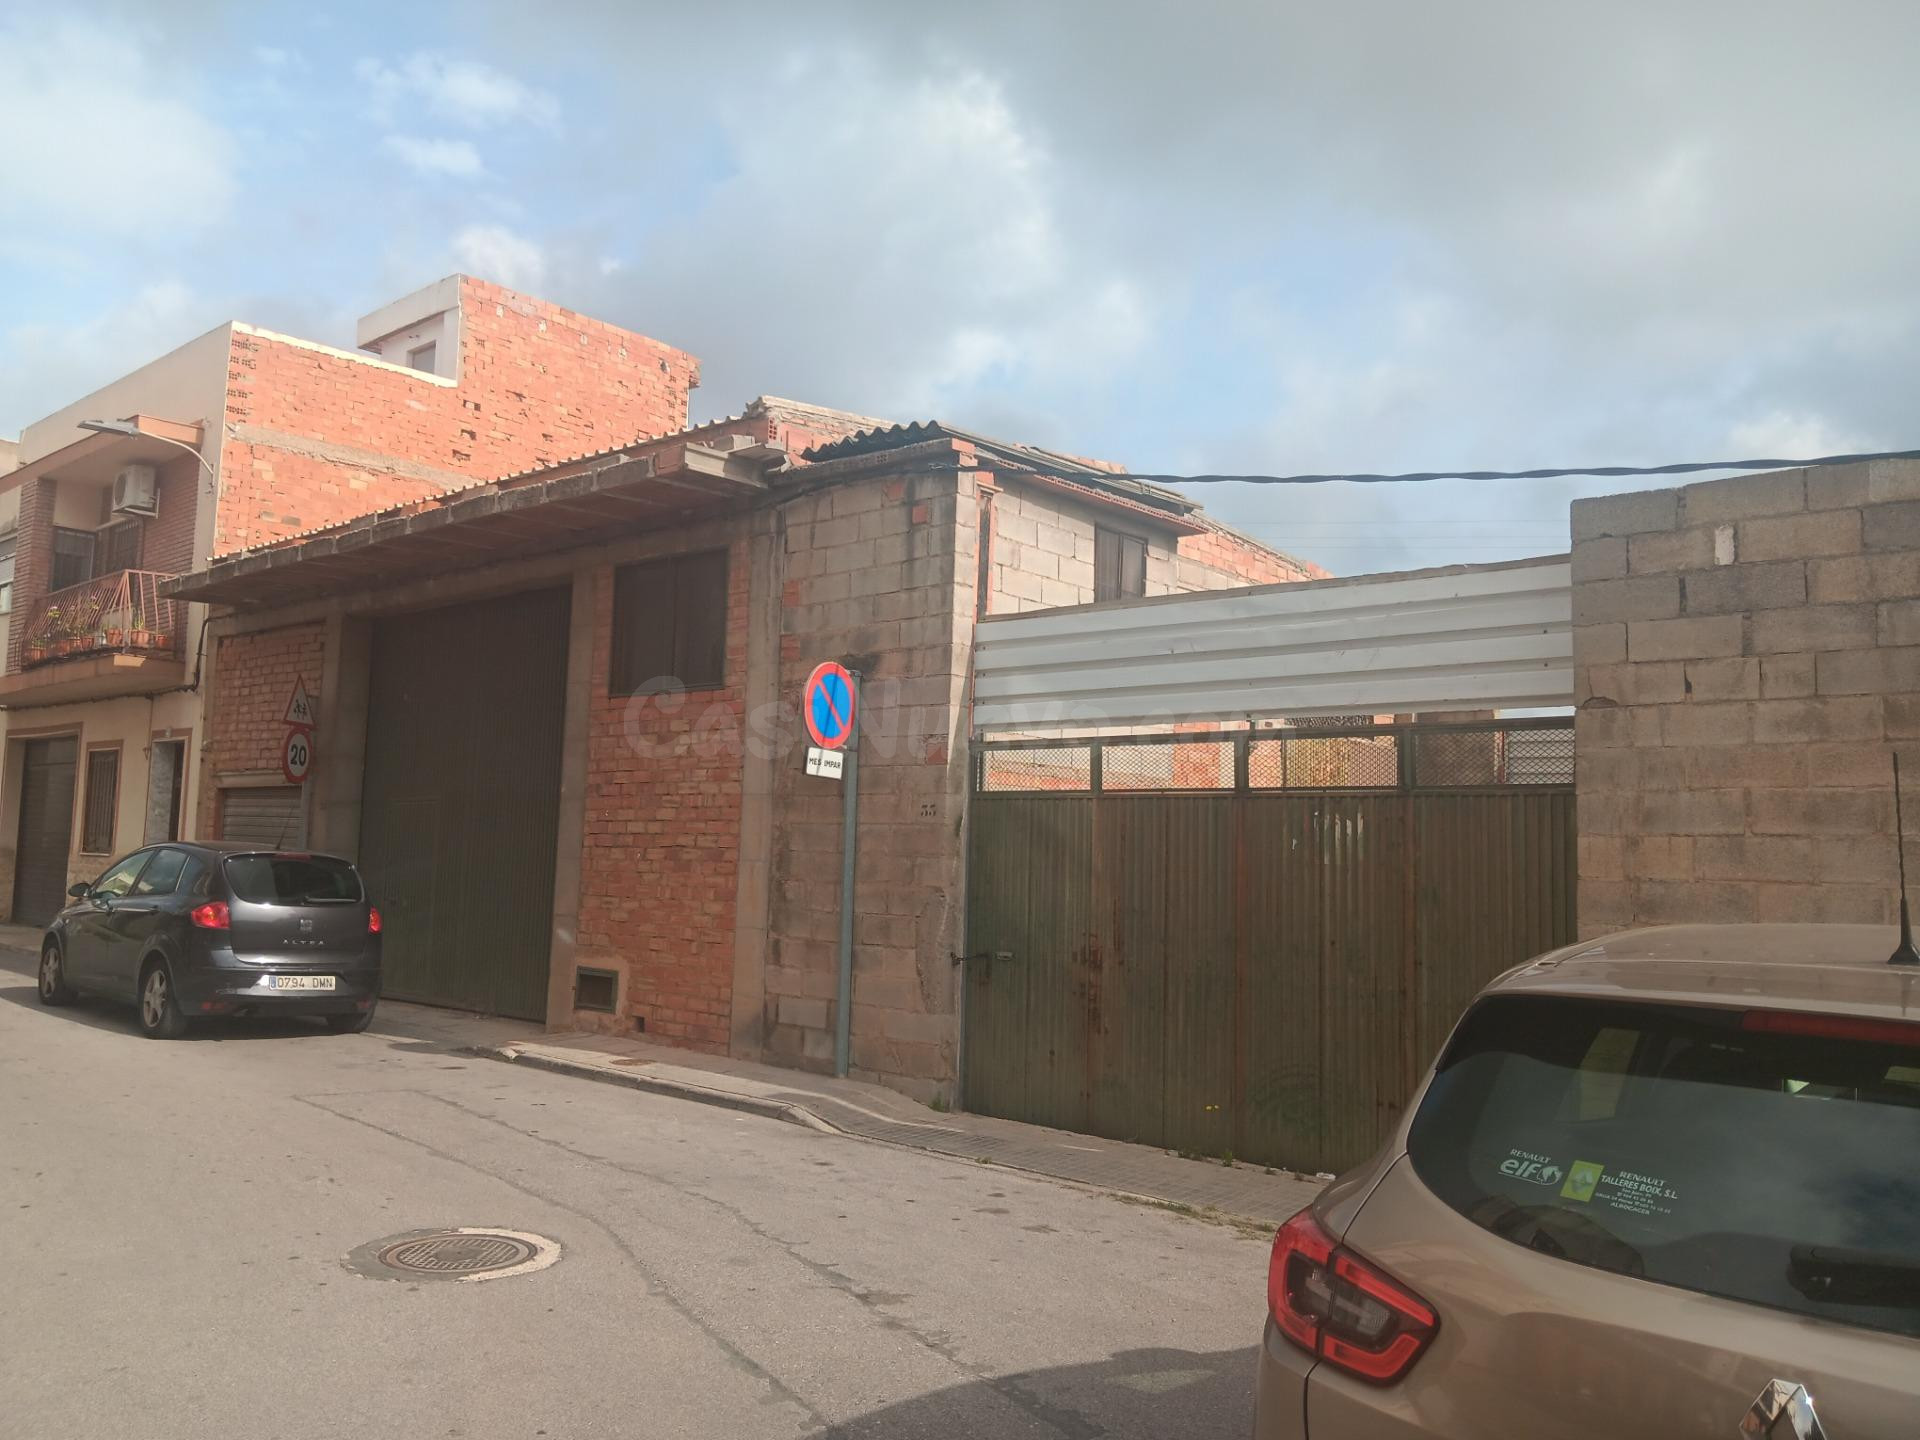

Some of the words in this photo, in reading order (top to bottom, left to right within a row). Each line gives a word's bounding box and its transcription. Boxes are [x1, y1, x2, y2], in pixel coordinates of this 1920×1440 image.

[290, 743, 307, 766] 20
[808, 757, 822, 766] MES
[824, 759, 841, 769] IMPAR
[277, 977, 305, 988] 0794
[312, 977, 333, 988] DMN
[1510, 1148, 1552, 1164] RENAULT
[1601, 1175, 1639, 1190] TALLERES
[1619, 1171, 1665, 1187] RENAULT
